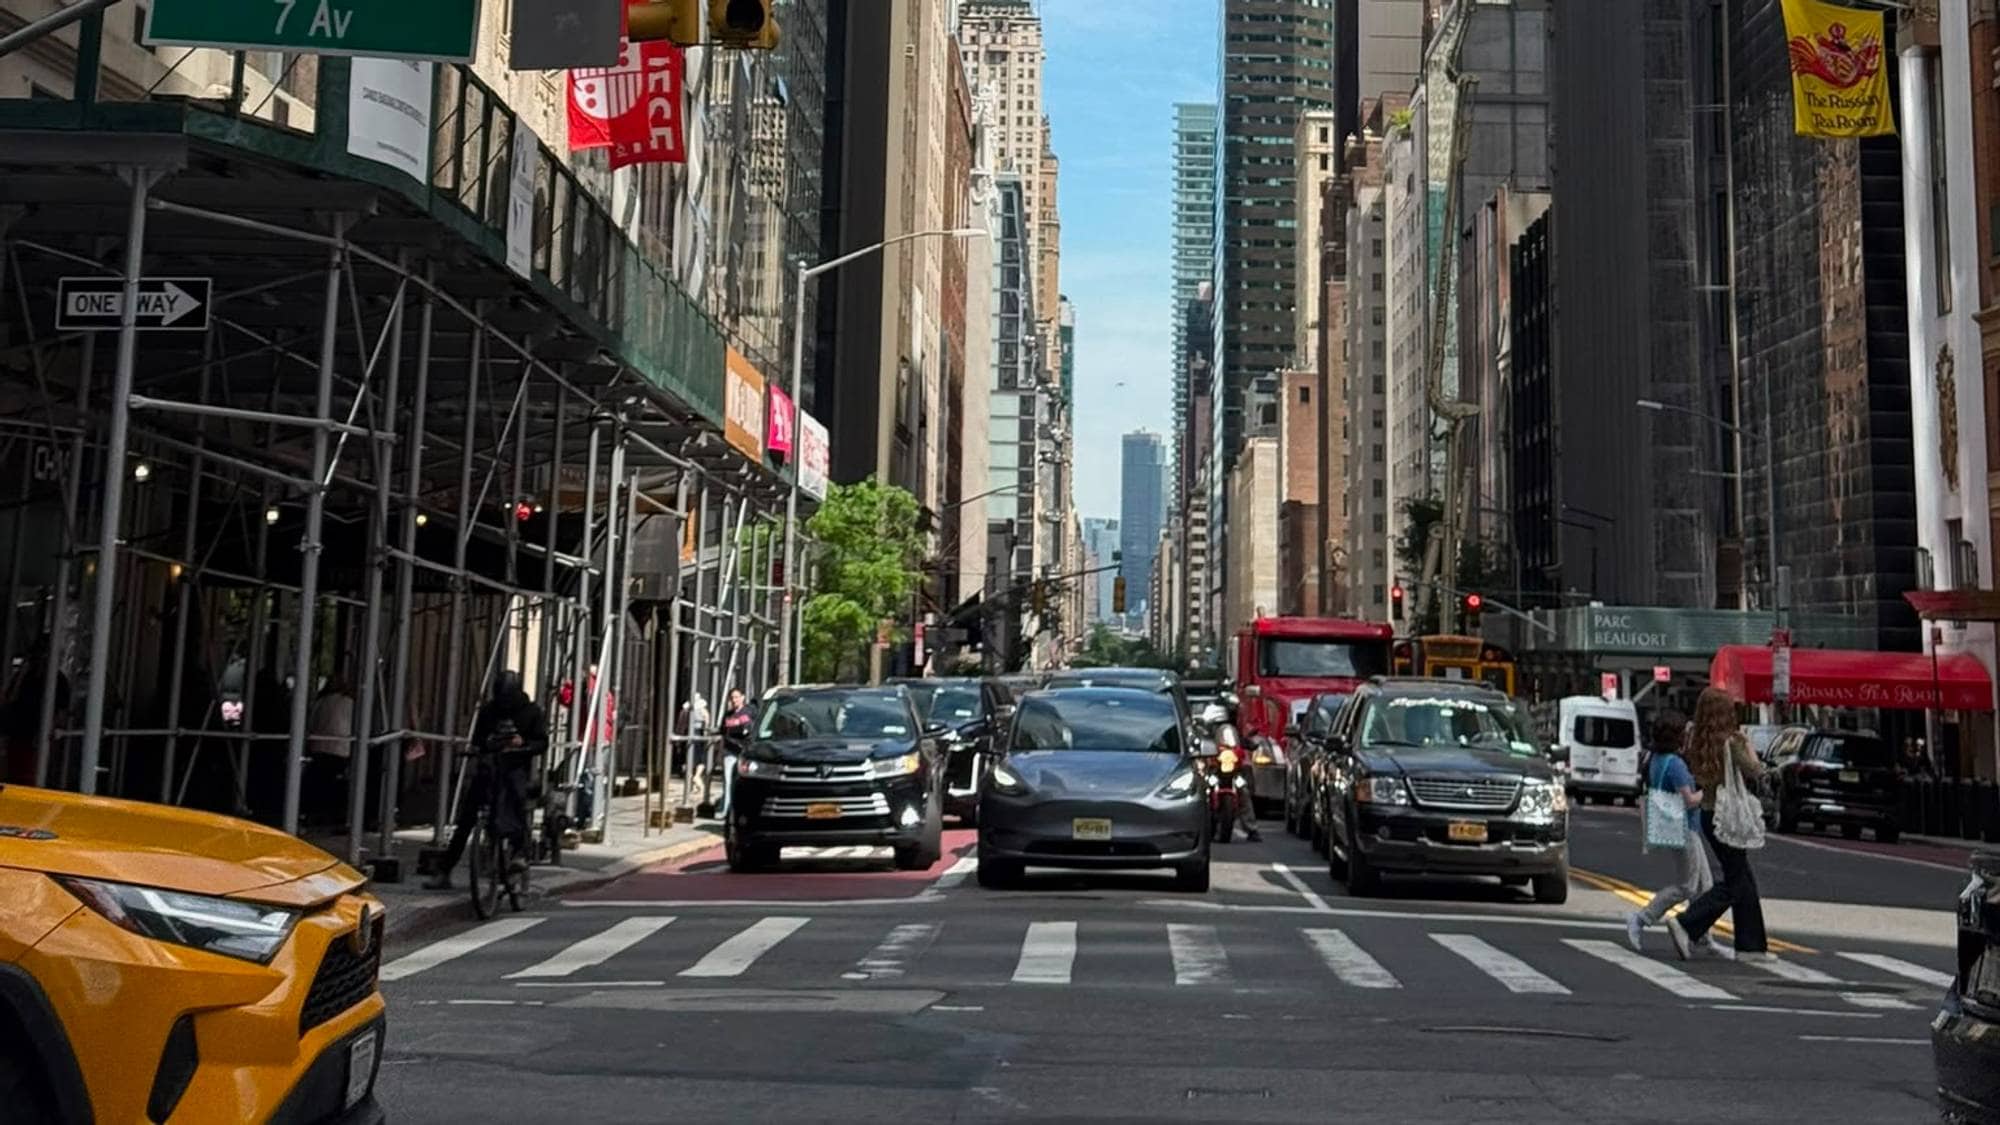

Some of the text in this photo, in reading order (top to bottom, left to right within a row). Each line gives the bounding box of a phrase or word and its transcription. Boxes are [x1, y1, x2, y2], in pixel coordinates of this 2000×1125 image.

[274, 0, 353, 38] 7 Av
[1804, 91, 1880, 109] The Russian
[1812, 112, 1877, 128] Tea Room
[75, 294, 179, 313] ONE WAY
[1594, 614, 1631, 629] PARC
[1594, 631, 1667, 646] BEAUFORT
